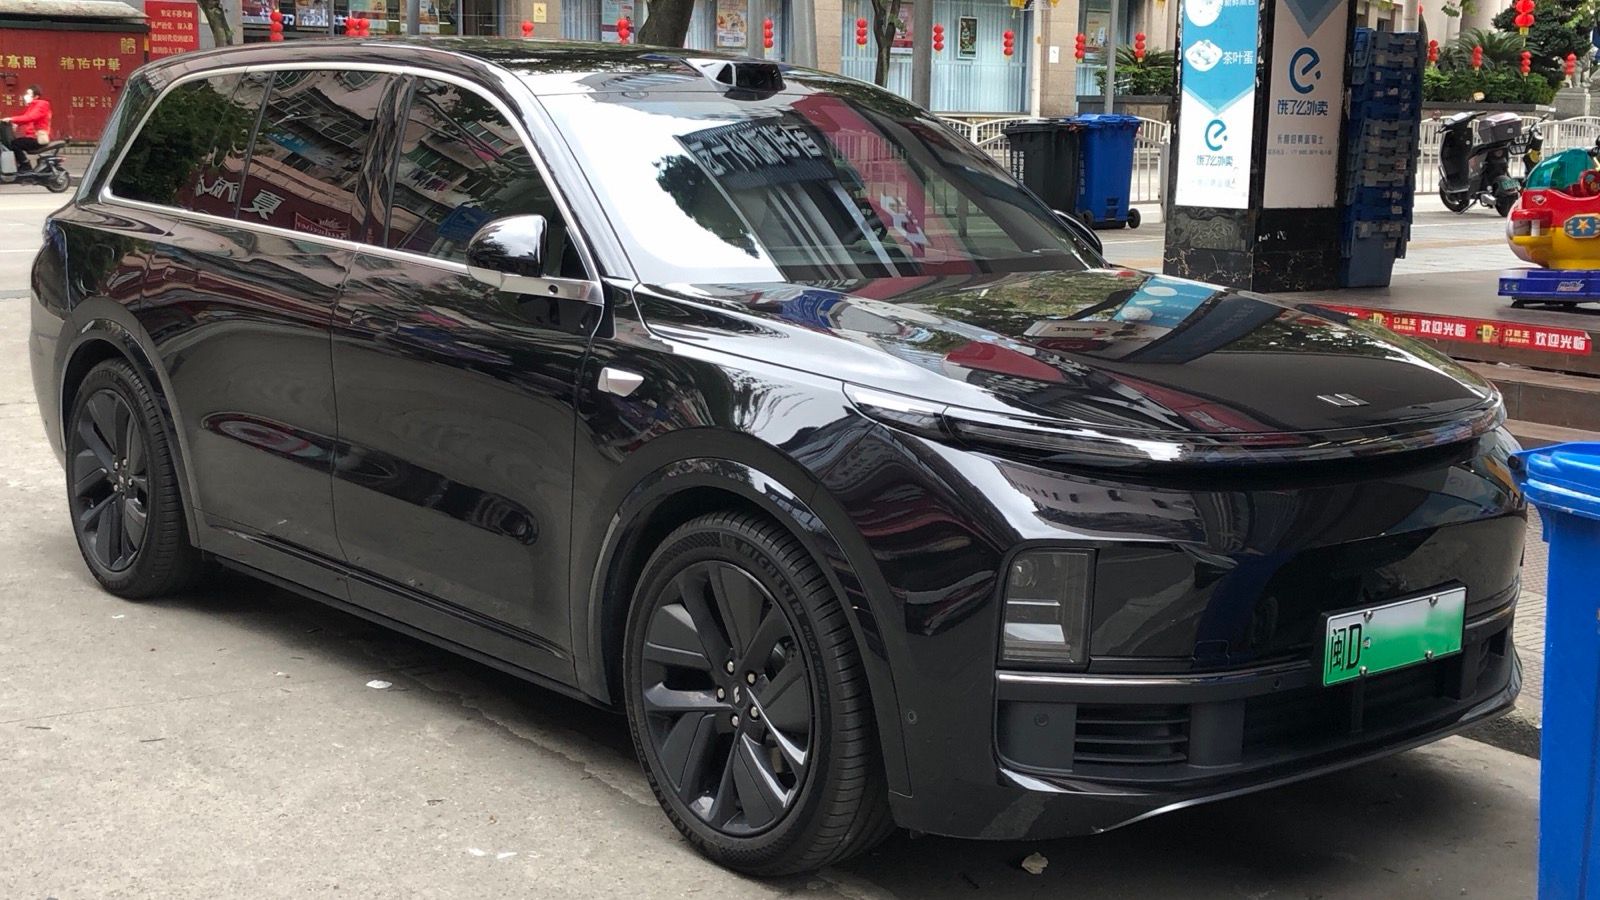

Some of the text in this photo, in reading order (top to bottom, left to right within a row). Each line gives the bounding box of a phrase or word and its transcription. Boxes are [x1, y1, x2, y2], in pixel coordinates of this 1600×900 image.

[1223, 51, 1254, 65] 茶叶蛋
[1277, 99, 1329, 116] 饿了么外卖
[1196, 154, 1234, 167] 饿了么外卖
[1420, 319, 1467, 337] 欢迎光临
[1535, 331, 1586, 350] 欢迎光临
[739, 542, 804, 616] MICHELIN
